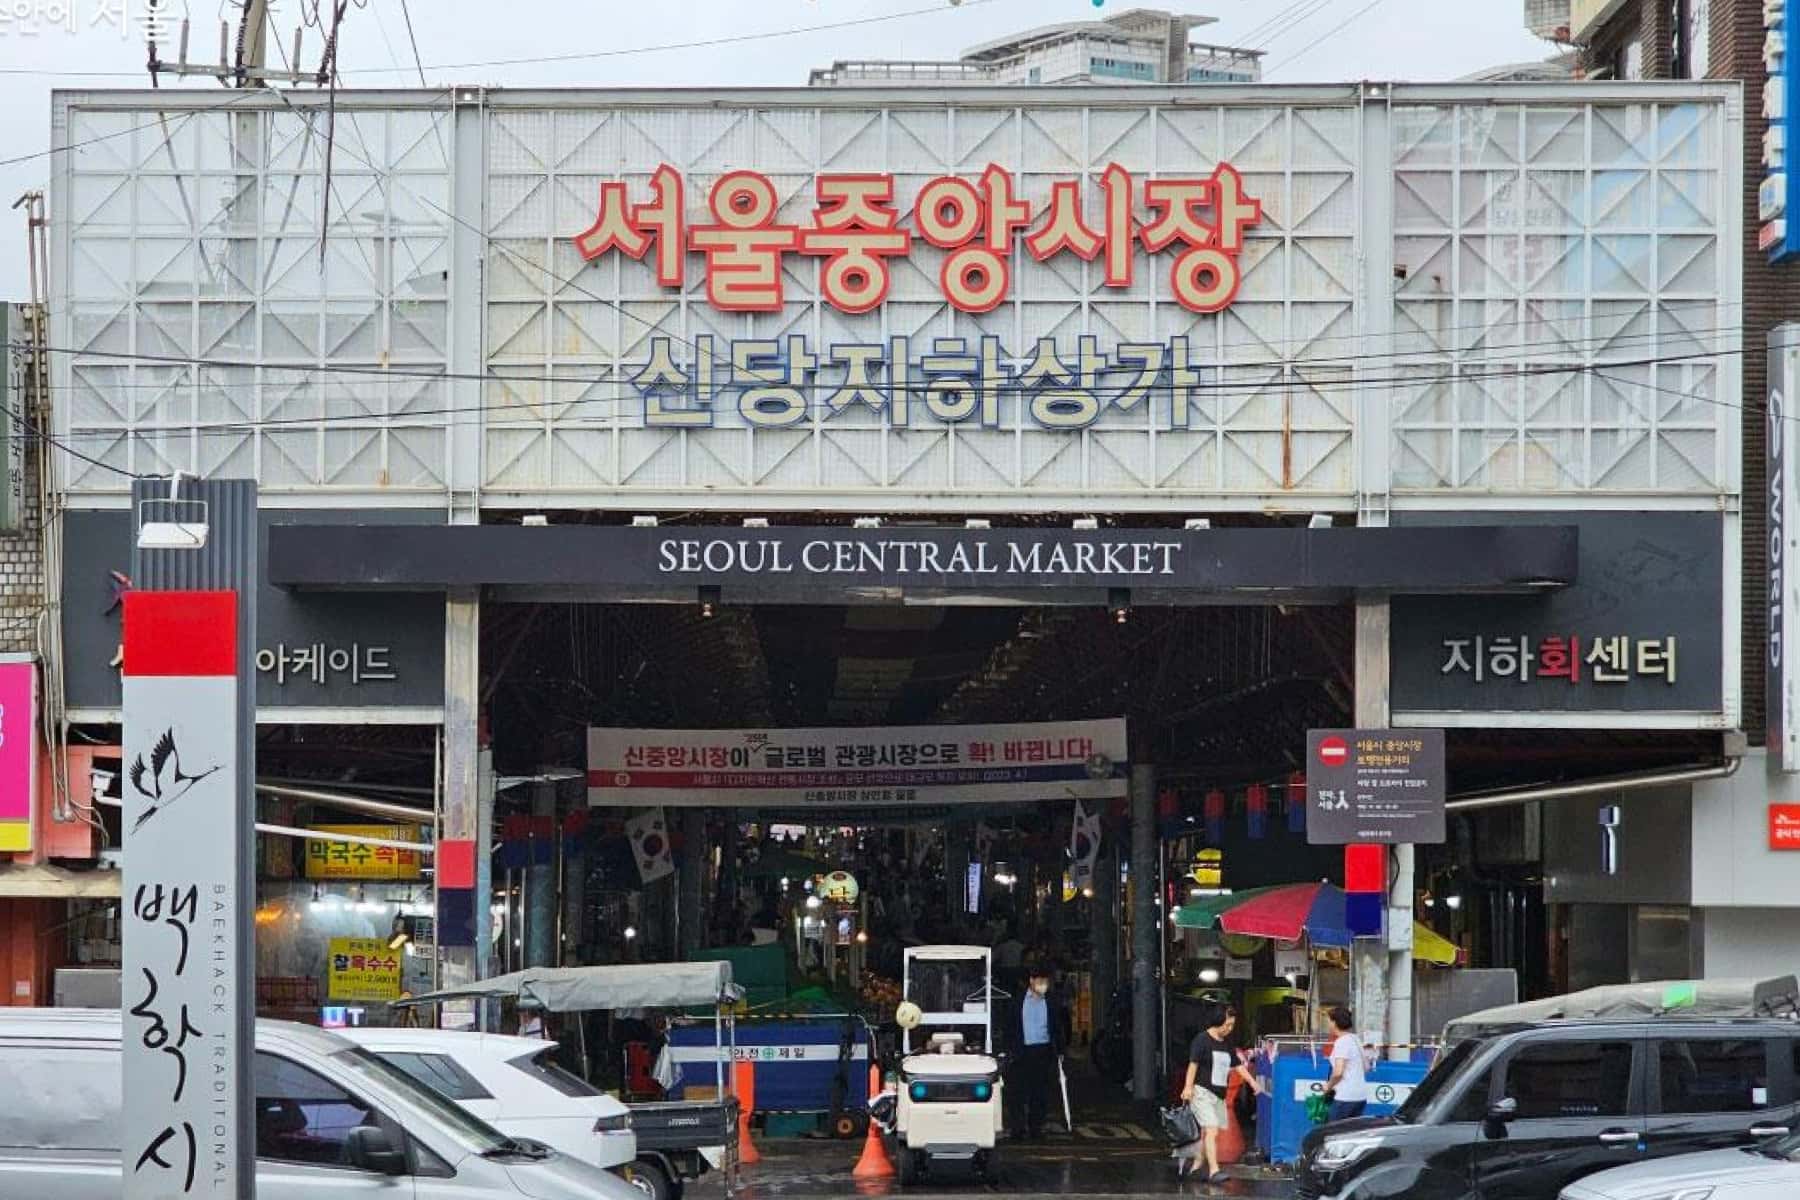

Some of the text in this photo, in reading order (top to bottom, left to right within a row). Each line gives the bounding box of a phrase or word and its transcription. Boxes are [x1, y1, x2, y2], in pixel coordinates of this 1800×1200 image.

[574, 162, 1261, 314] 서울중앙시장
[631, 334, 1202, 430] 신당지하상가
[658, 539, 1182, 576] SEOUL CENTRAL MARKET
[1440, 634, 1677, 684] 지하회센터
[624, 746, 749, 769] 신중앙시장이
[835, 742, 961, 768] 관광시장으로
[212, 883, 227, 1015] BAEKHACK
